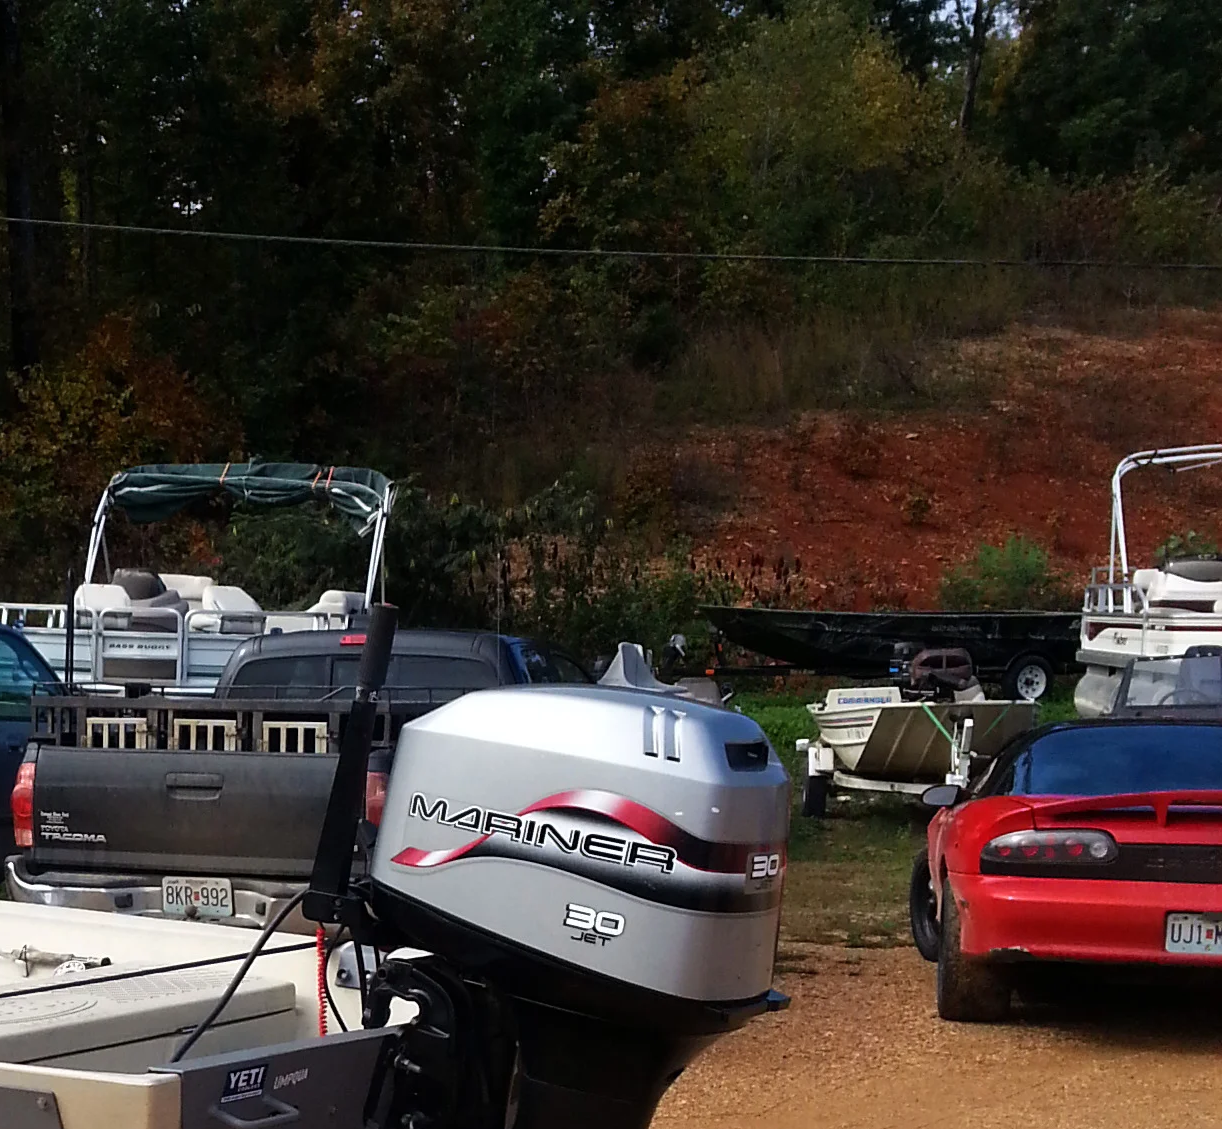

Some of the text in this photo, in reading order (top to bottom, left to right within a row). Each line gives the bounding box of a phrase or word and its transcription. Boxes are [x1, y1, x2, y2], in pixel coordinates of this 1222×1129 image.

[40, 832, 107, 843] TACOMA
[409, 791, 678, 875] MARINER
[751, 853, 780, 879] 30
[165, 885, 229, 908] 8KR 992
[563, 902, 626, 937] 30
[570, 931, 612, 947] JET
[229, 1066, 266, 1090] YETI
